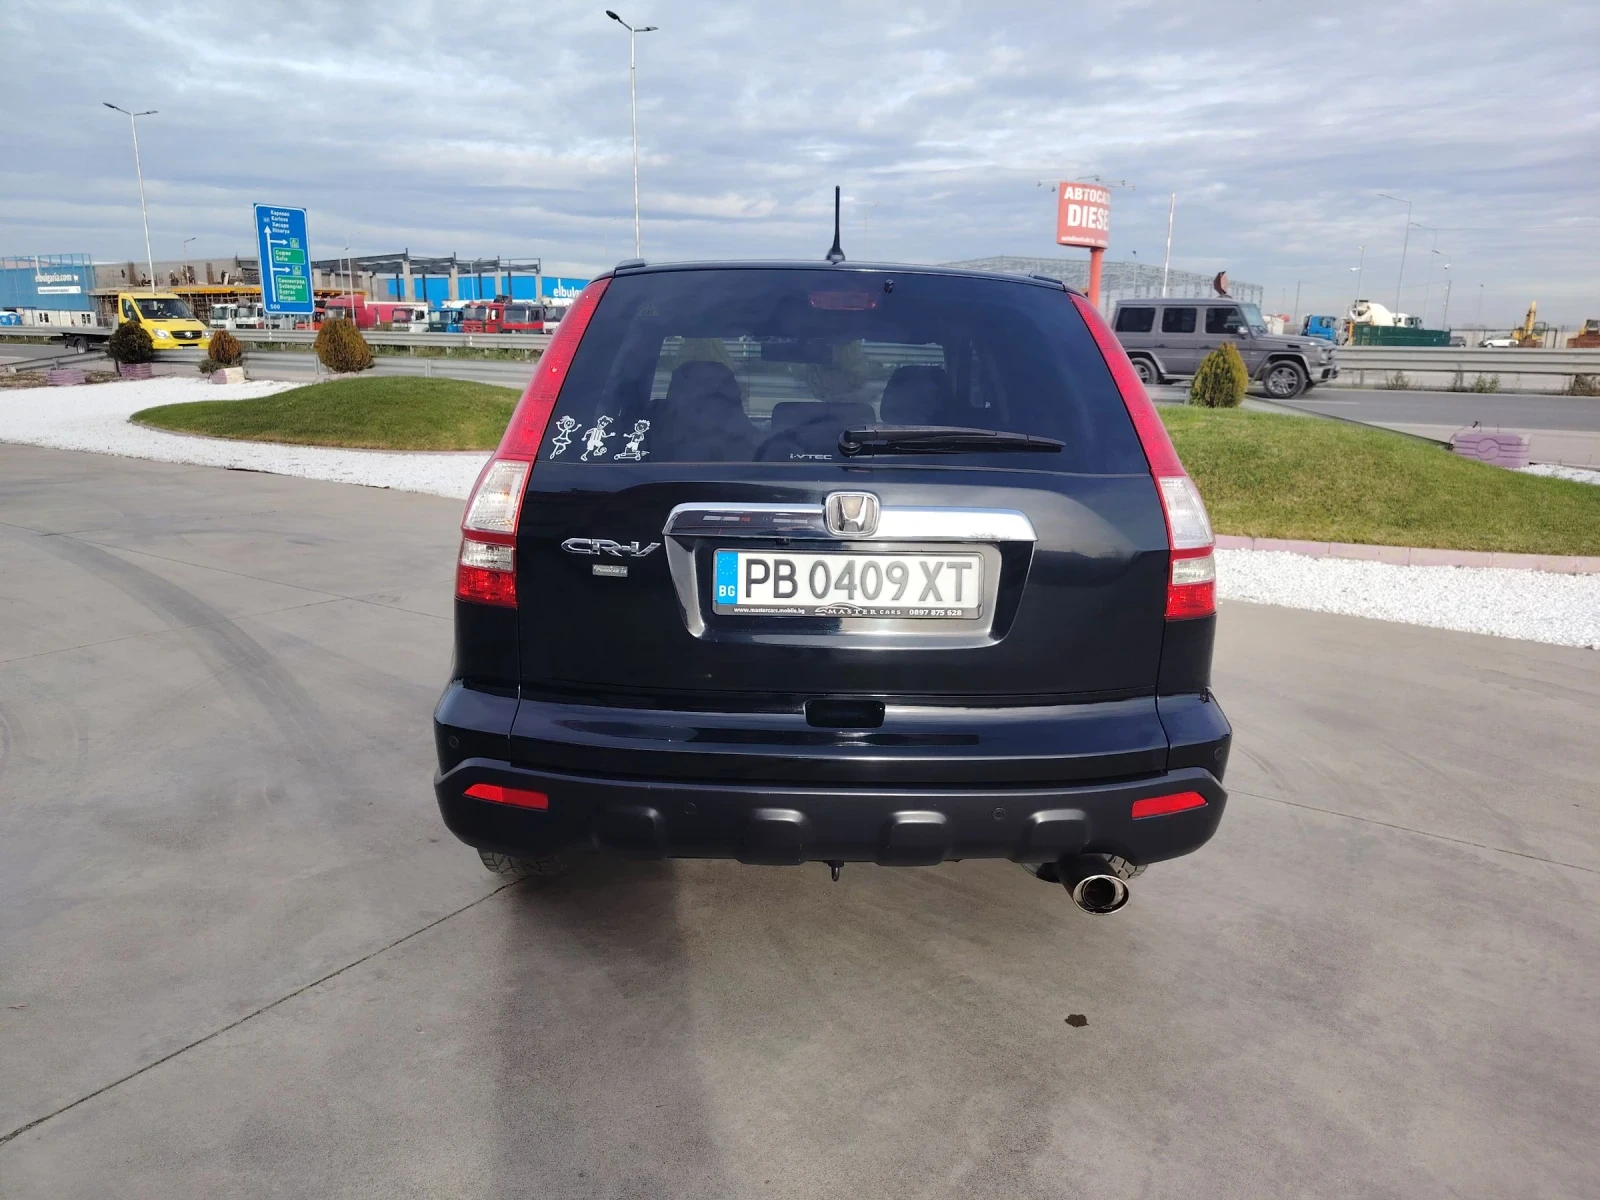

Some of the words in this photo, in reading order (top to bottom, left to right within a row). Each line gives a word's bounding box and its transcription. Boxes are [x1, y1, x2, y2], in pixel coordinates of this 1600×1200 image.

[561, 537, 661, 557] CR-V
[745, 558, 798, 599] PB
[809, 559, 910, 601] 0409
[918, 561, 972, 602] XT
[718, 585, 736, 597] BG
[733, 607, 806, 615] www.mastercars.mobile.bg
[909, 608, 929, 616] 0897
